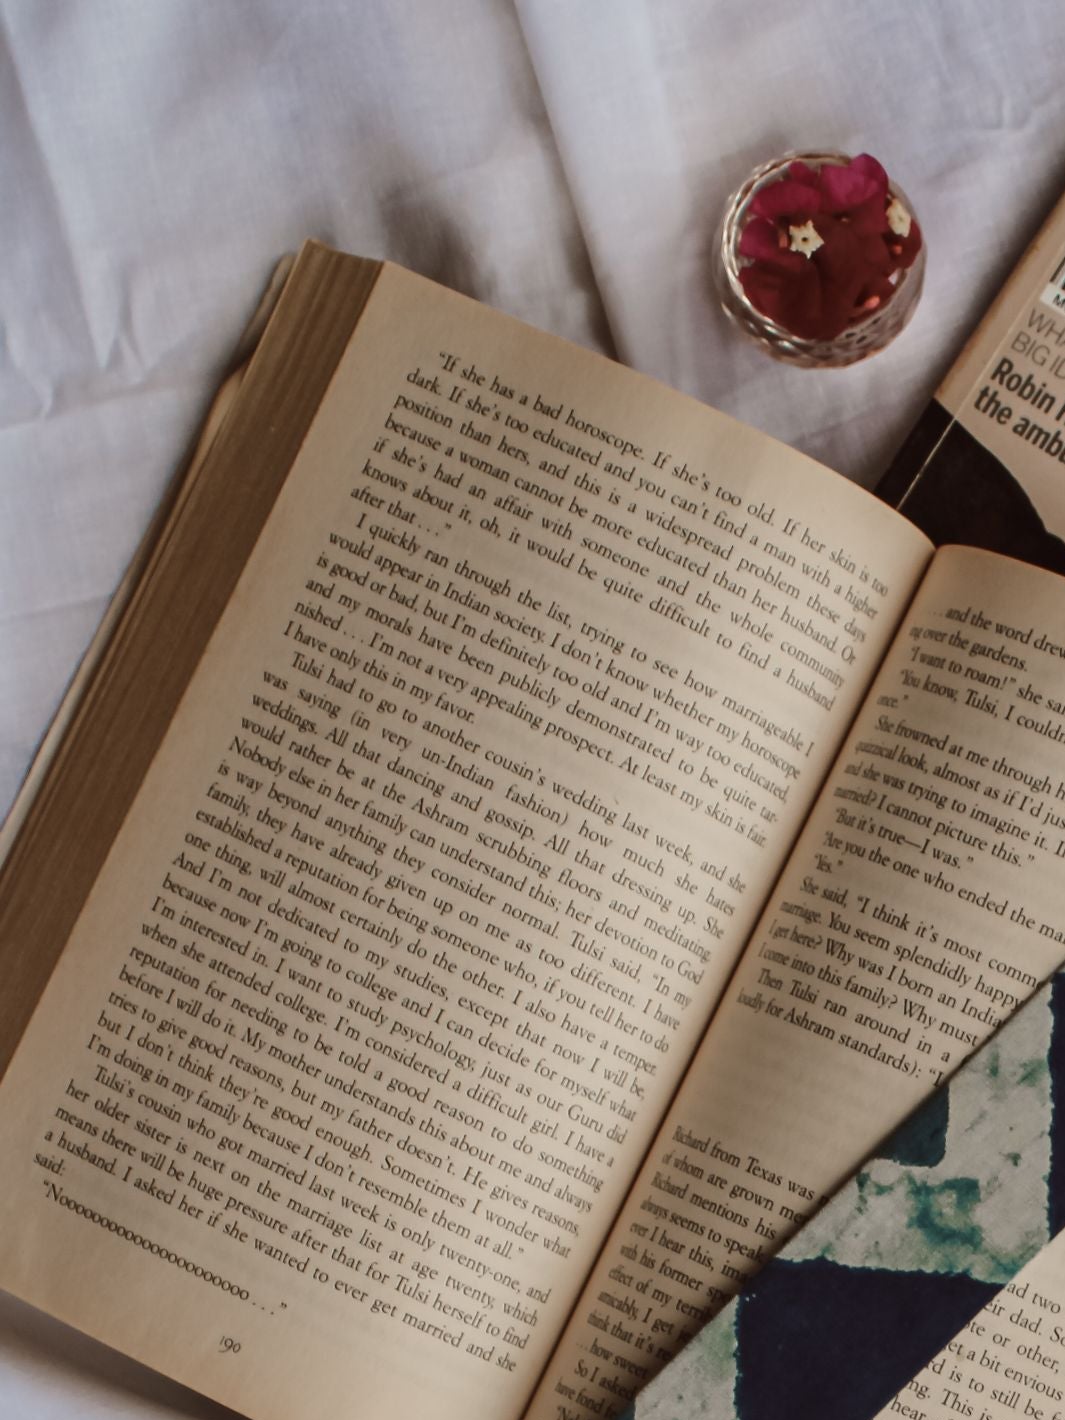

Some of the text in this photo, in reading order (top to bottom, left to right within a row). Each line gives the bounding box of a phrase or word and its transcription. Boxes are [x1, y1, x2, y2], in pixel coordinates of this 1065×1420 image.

[1010, 330, 1050, 367] BIG
[973, 385, 1013, 425] the
[990, 357, 1056, 414] Robin
[460, 364, 486, 386] she
[489, 375, 515, 399] has
[518, 395, 528, 406] a
[532, 394, 564, 420] bad
[564, 408, 644, 460] horoscope.
[652, 451, 671, 469] If
[715, 486, 742, 506] too
[747, 502, 775, 525] old.
[782, 518, 796, 536] If
[800, 527, 826, 553] her
[871, 578, 888, 597] too
[945, 630, 1027, 671] the gardens.
[969, 610, 992, 630] the
[995, 622, 1034, 645] word
[944, 659, 963, 674] to
[1016, 683, 1043, 705] she
[228, 735, 705, 985] Nobody else in her family can understand this; her devotion to God
[872, 903, 910, 931] think
[943, 938, 982, 962] most
[33, 1153, 65, 1176] said:
[709, 1141, 815, 1201] from Texas was
[137, 1094, 182, 1123] cousin
[187, 1117, 216, 1139] who
[216, 1136, 243, 1154] got
[246, 1149, 308, 1186] married
[308, 1175, 335, 1201] last
[341, 1195, 379, 1223] week
[383, 1214, 397, 1231] is
[401, 1227, 435, 1252] only
[439, 1244, 520, 1293] twenty-one,
[525, 1287, 552, 1304] and
[44, 1130, 516, 1372] a husband. I asked her if she wanted to ever get married and she
[219, 1335, 241, 1353] 190
